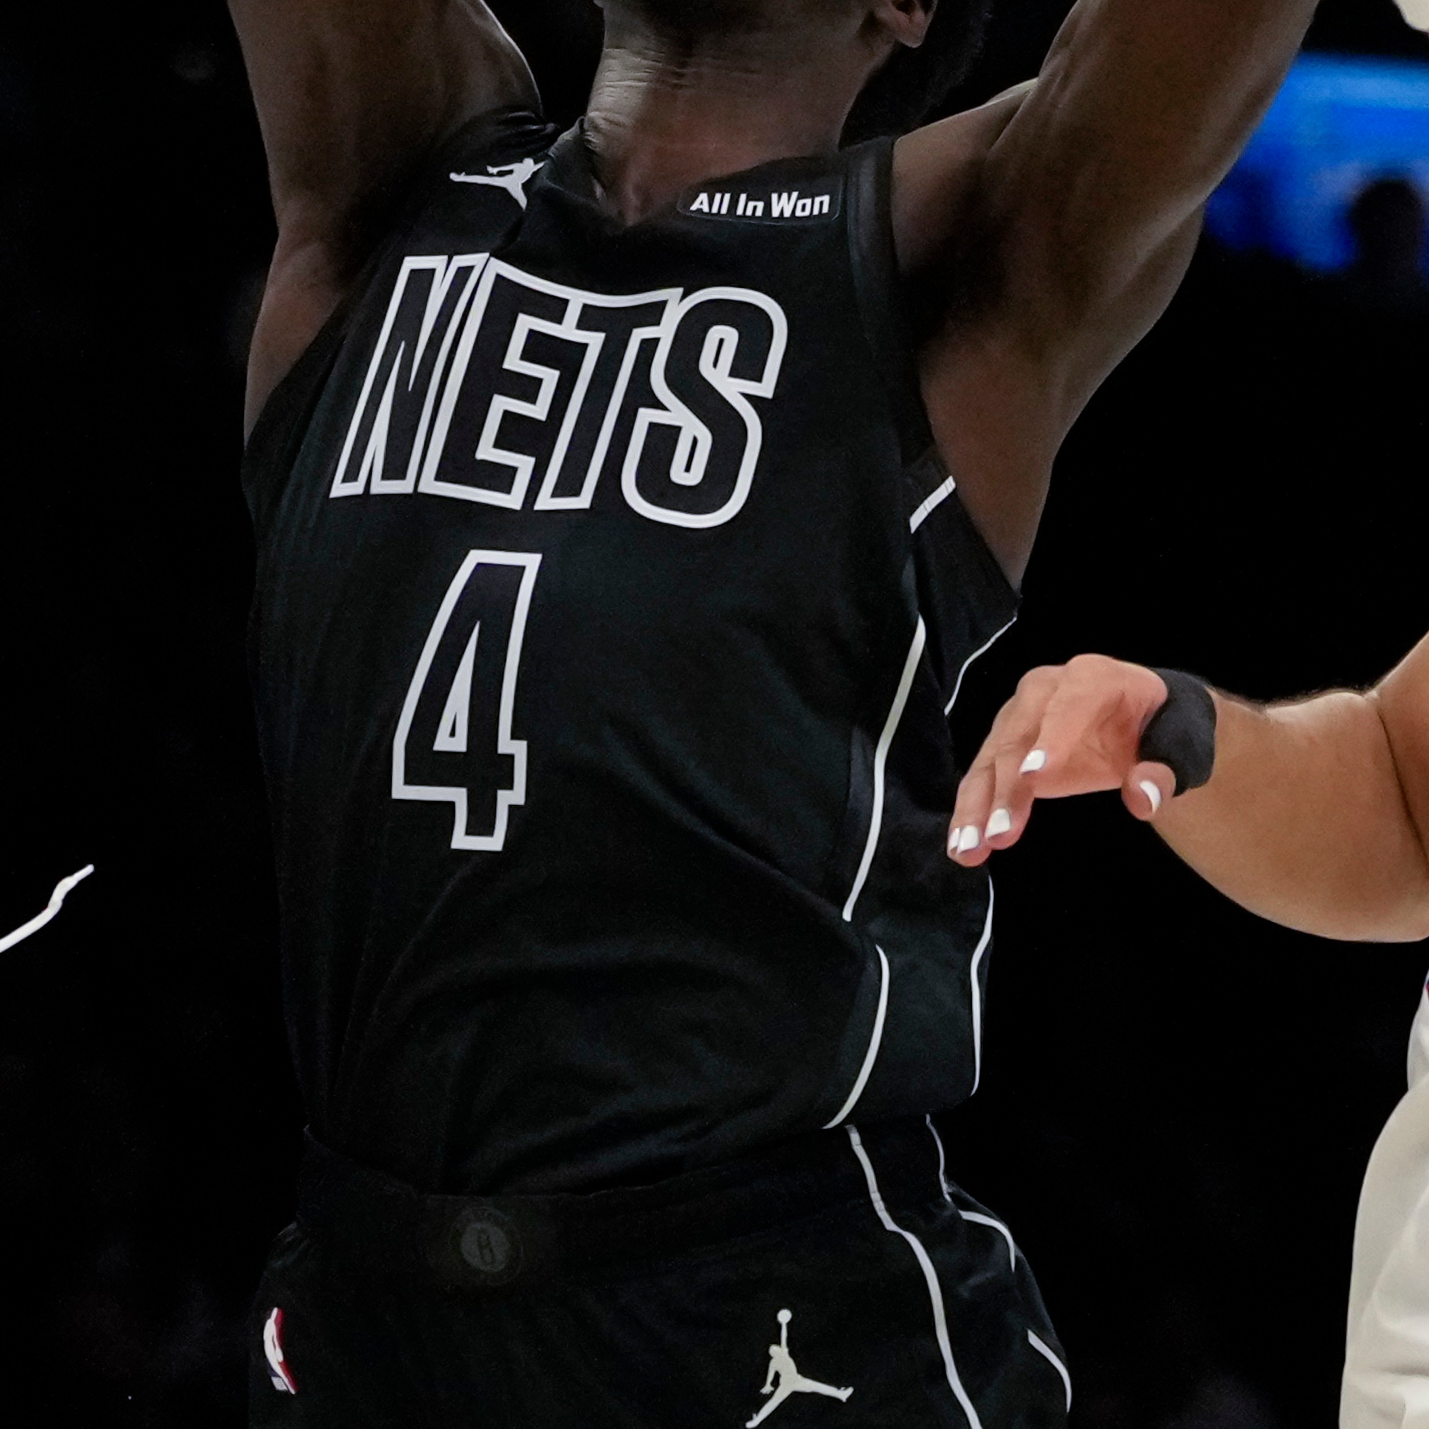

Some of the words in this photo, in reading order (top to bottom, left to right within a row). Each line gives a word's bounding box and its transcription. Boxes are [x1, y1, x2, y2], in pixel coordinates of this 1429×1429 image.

[689, 192, 731, 215] All
[736, 193, 765, 217] In
[770, 191, 831, 218] Won
[329, 252, 788, 529] NETS
[391, 548, 543, 852] 4
